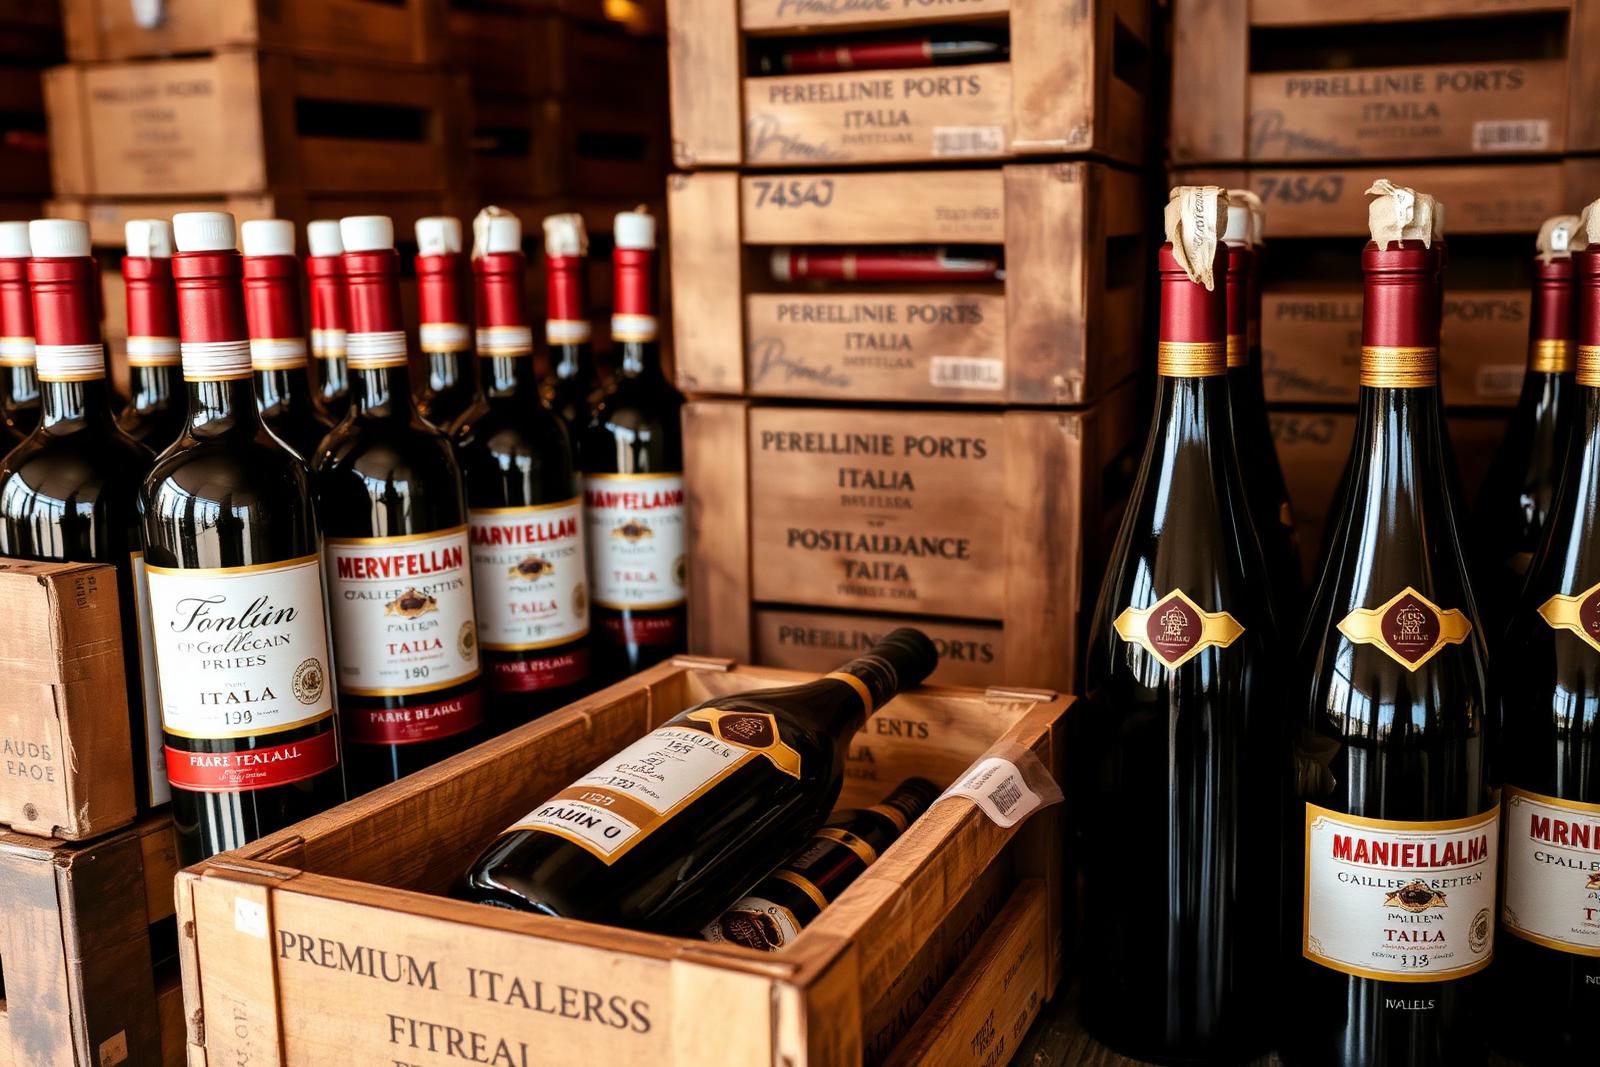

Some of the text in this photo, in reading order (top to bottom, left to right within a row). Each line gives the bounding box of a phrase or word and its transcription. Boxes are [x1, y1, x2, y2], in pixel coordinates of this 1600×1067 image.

[904, 75, 981, 98] PORTS
[1436, 68, 1523, 93] PORTS
[844, 110, 910, 128] ITALIA
[906, 303, 984, 324] PORTS
[845, 332, 912, 350] ITALIA
[761, 431, 987, 459] PERELLINIE PORTS
[838, 468, 915, 490] ITALIA
[930, 637, 994, 662] ORTS
[200, 686, 277, 706] ITALA
[278, 929, 652, 1034] PREMIUM ITALERSS
